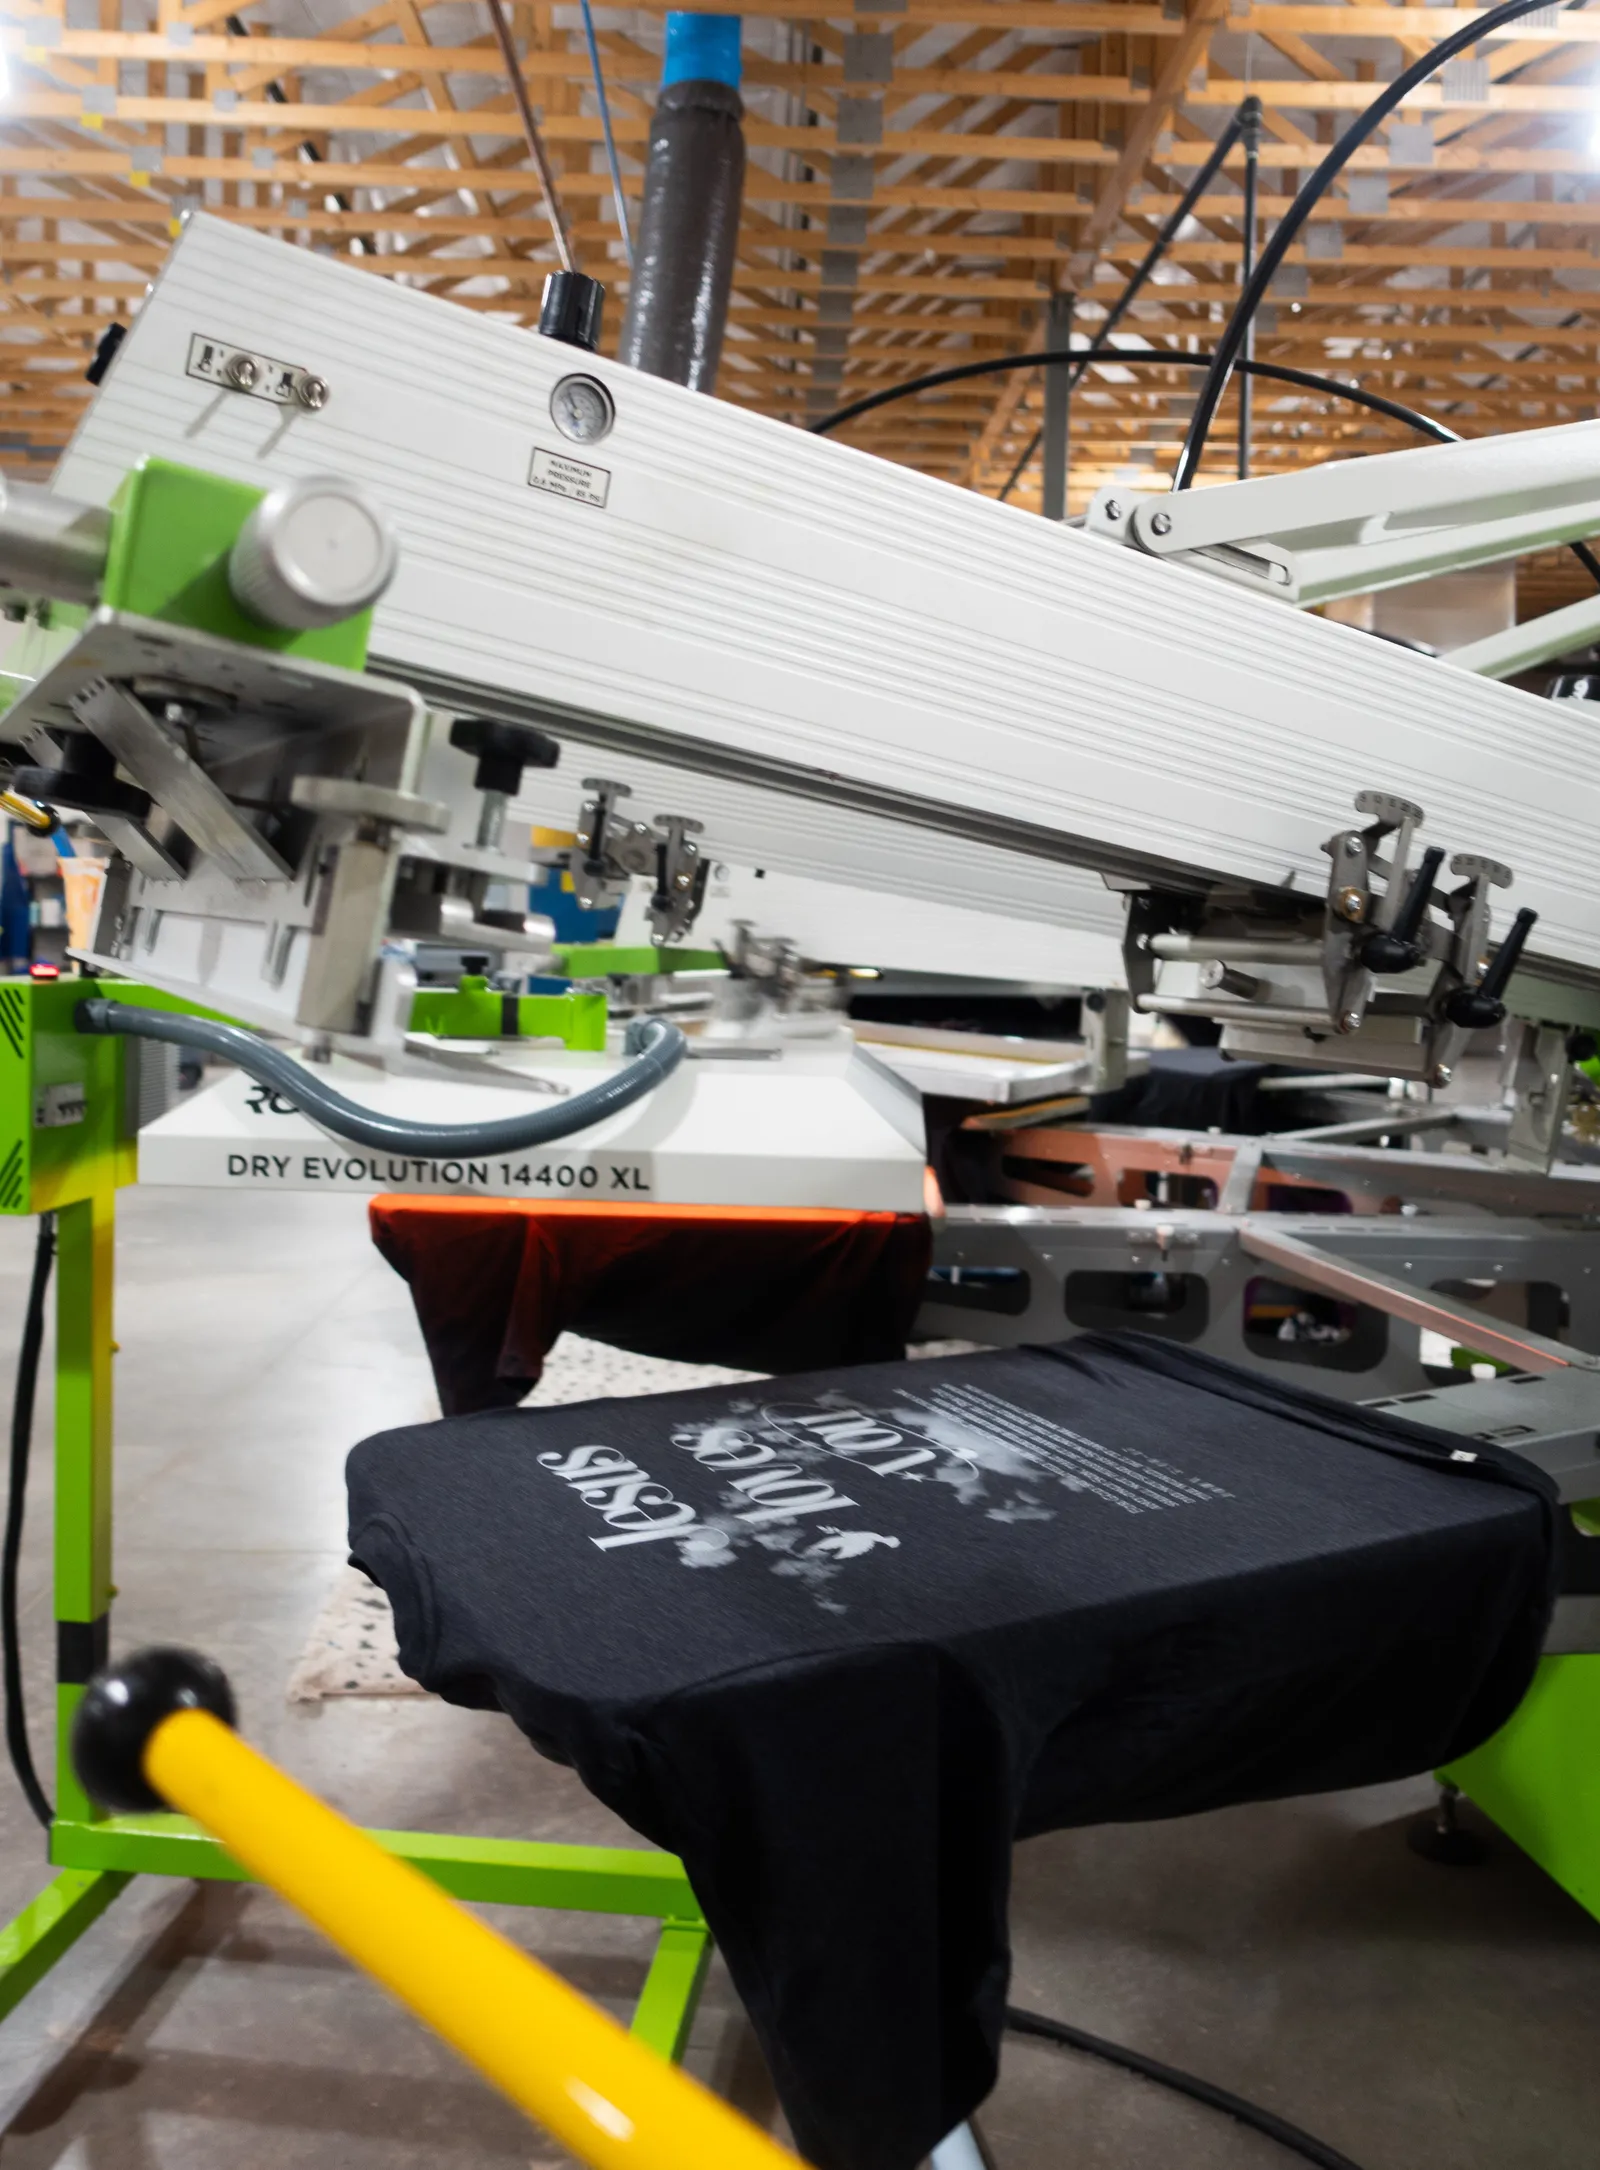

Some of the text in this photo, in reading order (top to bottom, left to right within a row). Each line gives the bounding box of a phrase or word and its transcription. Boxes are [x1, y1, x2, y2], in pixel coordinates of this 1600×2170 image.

[228, 1155, 650, 1191] DRY EVOLUTION 14400 XL
[536, 1445, 731, 1552] Jesus
[669, 1427, 860, 1524] loves
